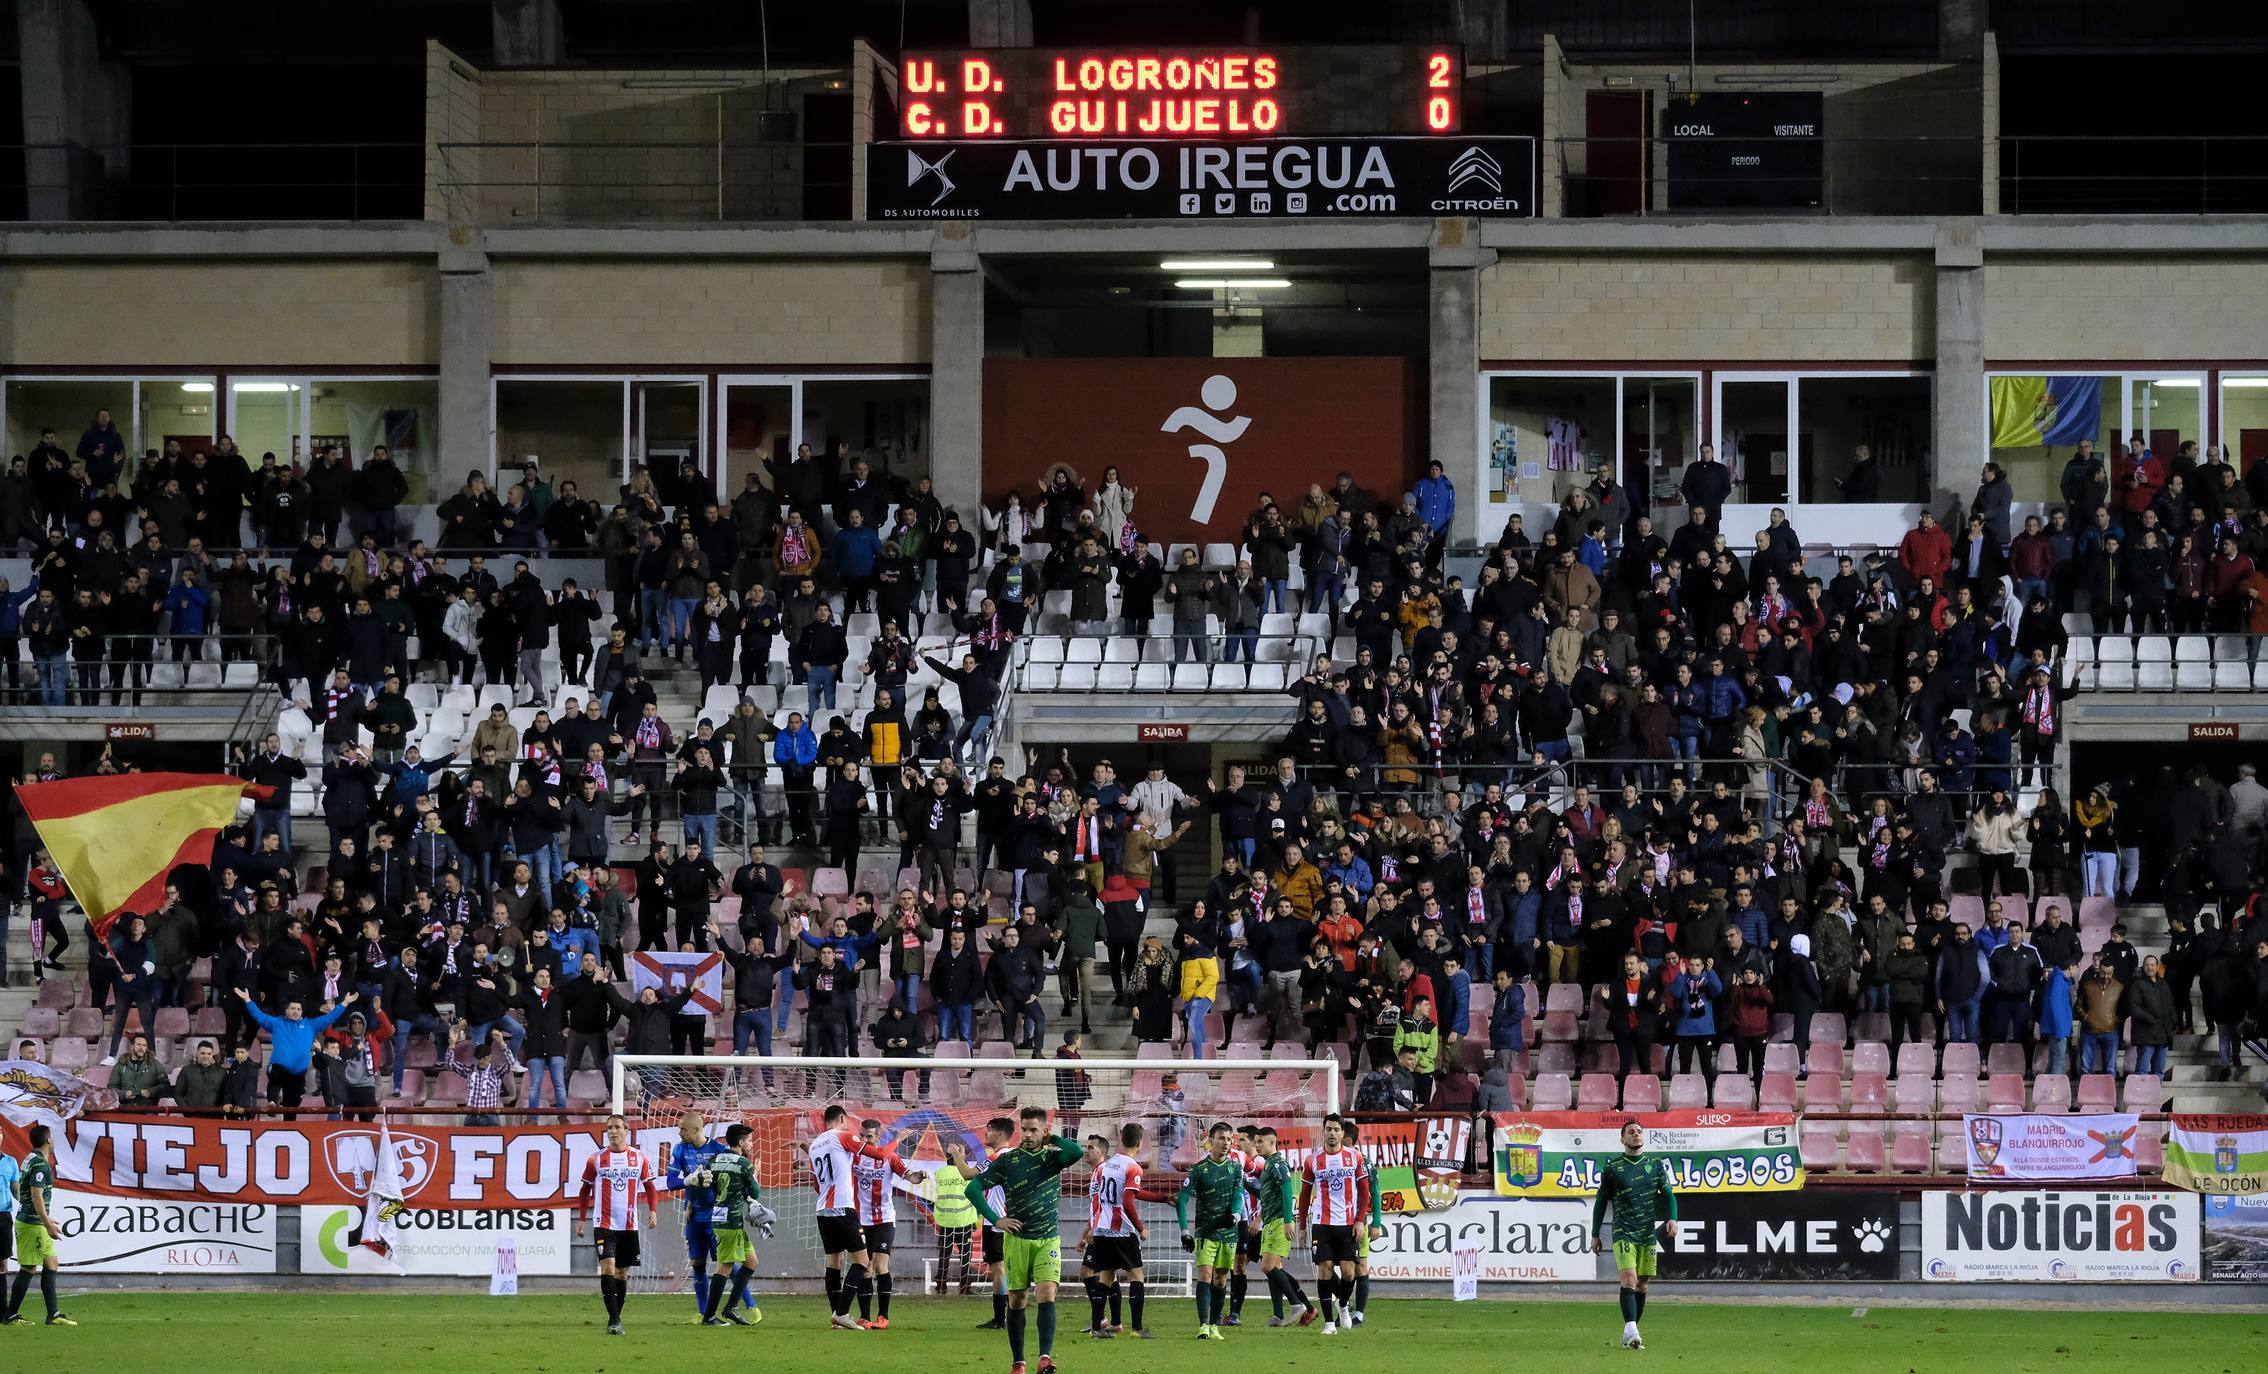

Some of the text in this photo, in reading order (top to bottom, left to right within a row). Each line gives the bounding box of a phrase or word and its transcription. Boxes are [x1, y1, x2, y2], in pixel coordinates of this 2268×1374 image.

[907, 56, 1450, 93] U. D. LOGROÑES 2
[907, 98, 1450, 134] C. D. GUIJUELO 0
[1674, 125, 1814, 136] LOCAL VISITANTE
[1731, 156, 1760, 166] PERIODO
[1002, 146, 1396, 192] AUTO IREGUA
[1326, 193, 1396, 212] .com
[884, 209, 980, 217] DS AUTOMOBILES
[2193, 727, 2234, 737] SALIDA
[1241, 765, 1278, 776] ALIDA
[1696, 1113, 1731, 1126] SILLERO
[2027, 1125, 2066, 1135] MADRID
[2009, 1138, 2085, 1149] BLANQUIRROJO
[50, 1119, 311, 1196] VIEJO
[815, 1153, 834, 1182] 21
[2219, 1174, 2261, 1192] OCÓN
[2135, 1194, 2150, 1202] Rioja
[1946, 1192, 2178, 1252] Noticias
[1369, 1210, 1593, 1255] eñaclara
[395, 1243, 468, 1257] PROMOCIÓN
[1618, 1240, 1631, 1253] 18
[168, 1247, 241, 1266] RIOJA
[1454, 1248, 1478, 1277] TOYOTA
[1368, 1265, 1411, 1278] AGUA
[1485, 1266, 1558, 1278] NATURAL
[2212, 1271, 2240, 1280] RENAULT
[2241, 1270, 2258, 1280] AUTO
